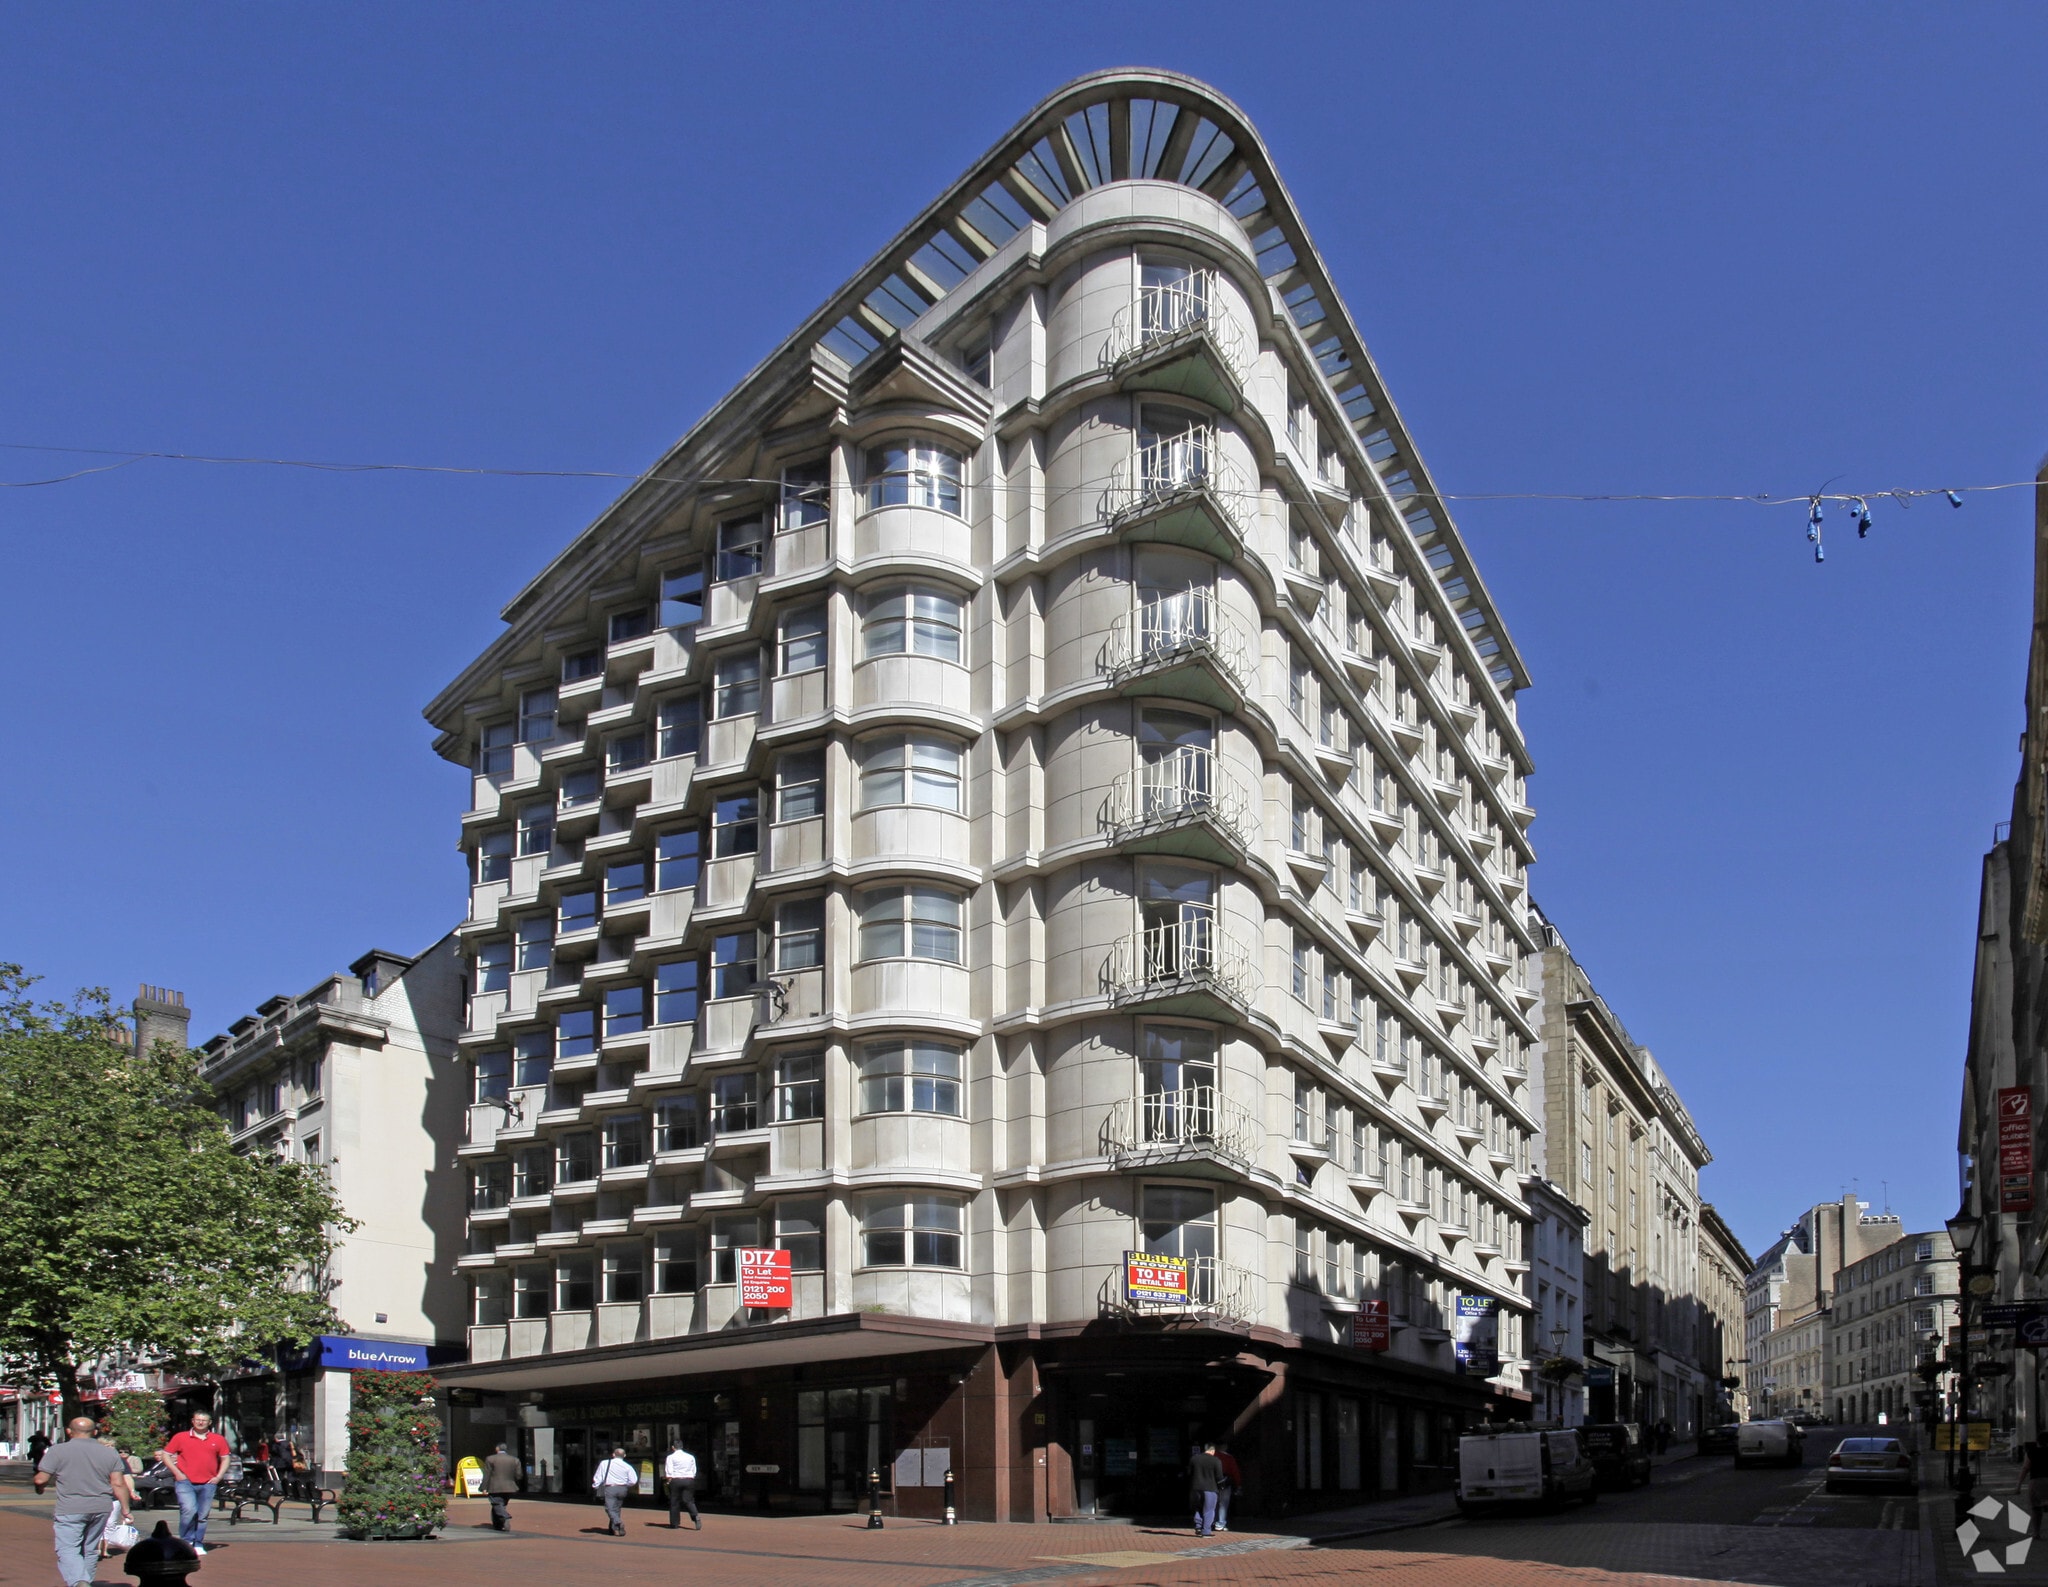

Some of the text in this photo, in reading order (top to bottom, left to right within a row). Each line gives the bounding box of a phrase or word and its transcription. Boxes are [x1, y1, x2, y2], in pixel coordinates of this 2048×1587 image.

[2001, 1123, 2028, 1132] office
[741, 1251, 776, 1265] DTZ
[1129, 1253, 1185, 1265] BURLEY
[1130, 1261, 1185, 1270] BROWNE
[757, 1268, 772, 1276] Let
[1136, 1268, 1180, 1281] TO LET
[1136, 1278, 1162, 1287] RETAIL
[1460, 1297, 1495, 1307] TO LET
[120, 1374, 139, 1383] LET
[590, 1405, 623, 1419] DIGITAL
[626, 1399, 689, 1417] SPECIALISTS
